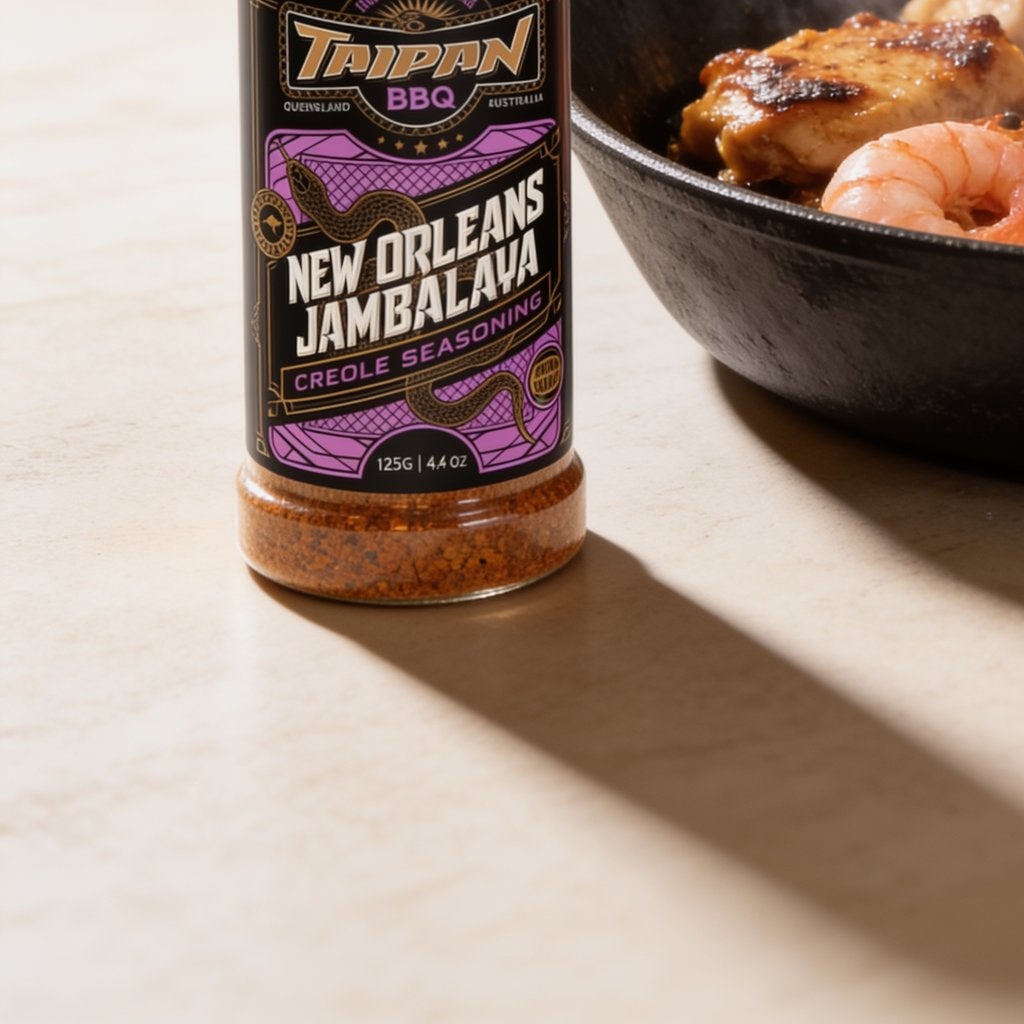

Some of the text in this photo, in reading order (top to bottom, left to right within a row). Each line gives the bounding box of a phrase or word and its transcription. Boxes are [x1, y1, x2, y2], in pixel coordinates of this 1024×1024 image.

[293, 14, 534, 80] TAIPAN
[387, 86, 457, 111] BBQ
[287, 239, 367, 304] NEW
[376, 168, 544, 286] ORLEANS
[296, 228, 539, 357] JAMBALAYA
[294, 291, 542, 392] CREOLE SEASONING
[377, 456, 413, 471] 125G
[449, 455, 468, 468] OZ
